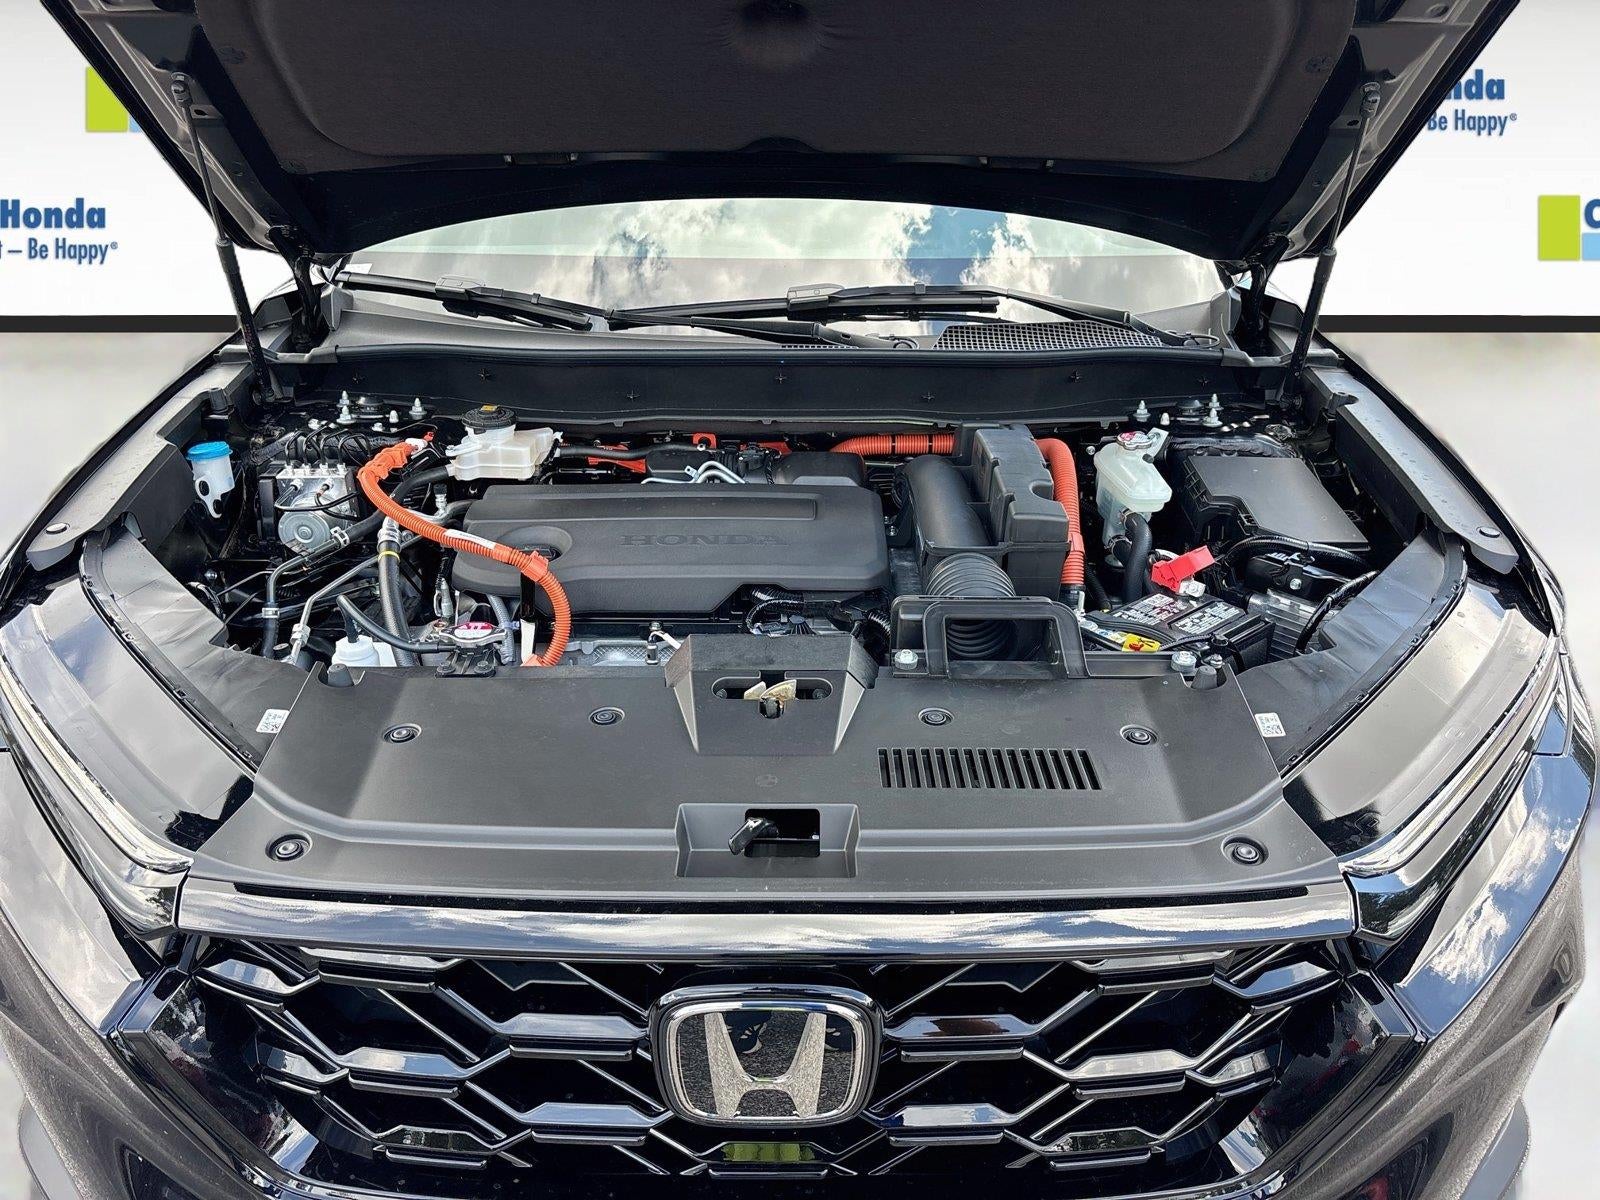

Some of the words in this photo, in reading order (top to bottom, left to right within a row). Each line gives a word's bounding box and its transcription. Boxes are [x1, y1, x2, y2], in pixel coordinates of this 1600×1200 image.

[0, 197, 106, 229] Honda
[28, 237, 49, 260] Be
[619, 534, 791, 547] HONDA
